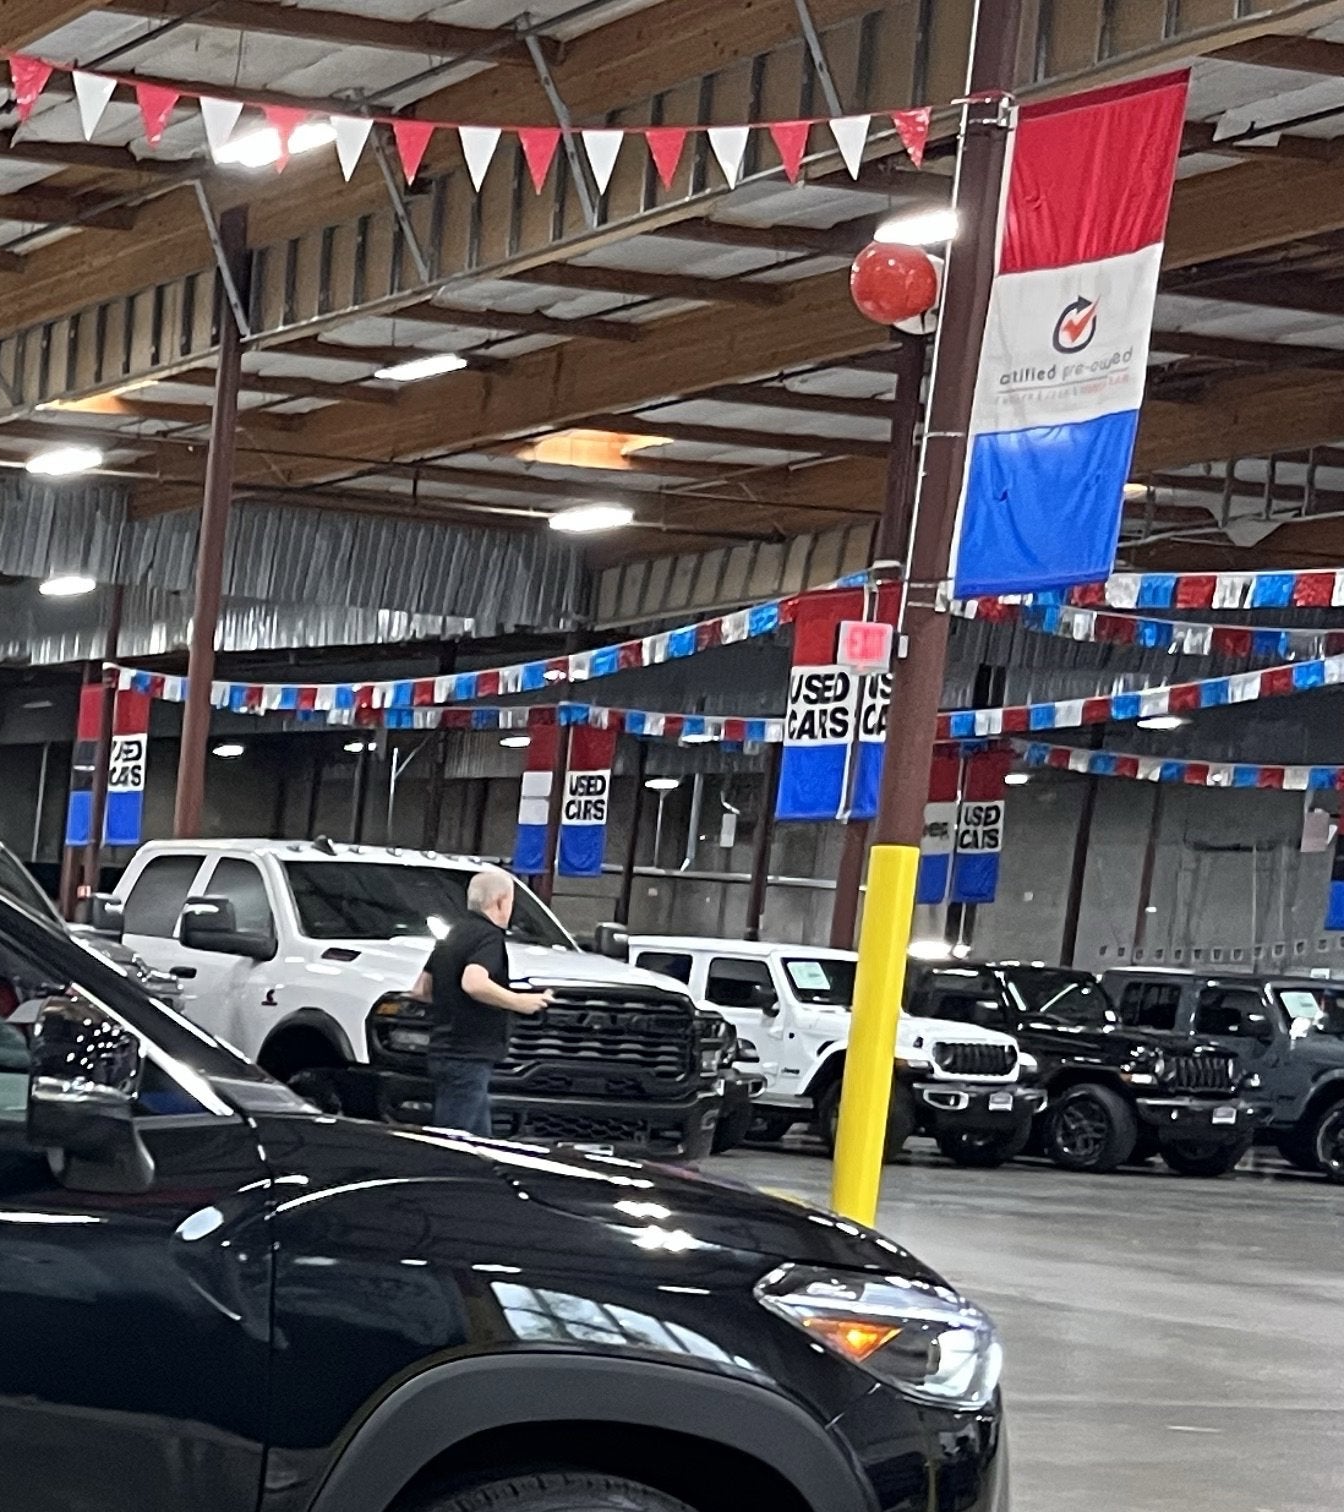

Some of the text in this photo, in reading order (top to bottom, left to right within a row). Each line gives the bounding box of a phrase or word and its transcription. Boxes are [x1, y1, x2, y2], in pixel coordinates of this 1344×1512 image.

[1062, 346, 1133, 380] pre-owed
[790, 671, 850, 704] USED
[787, 706, 850, 740] CARS
[569, 774, 607, 796] USED
